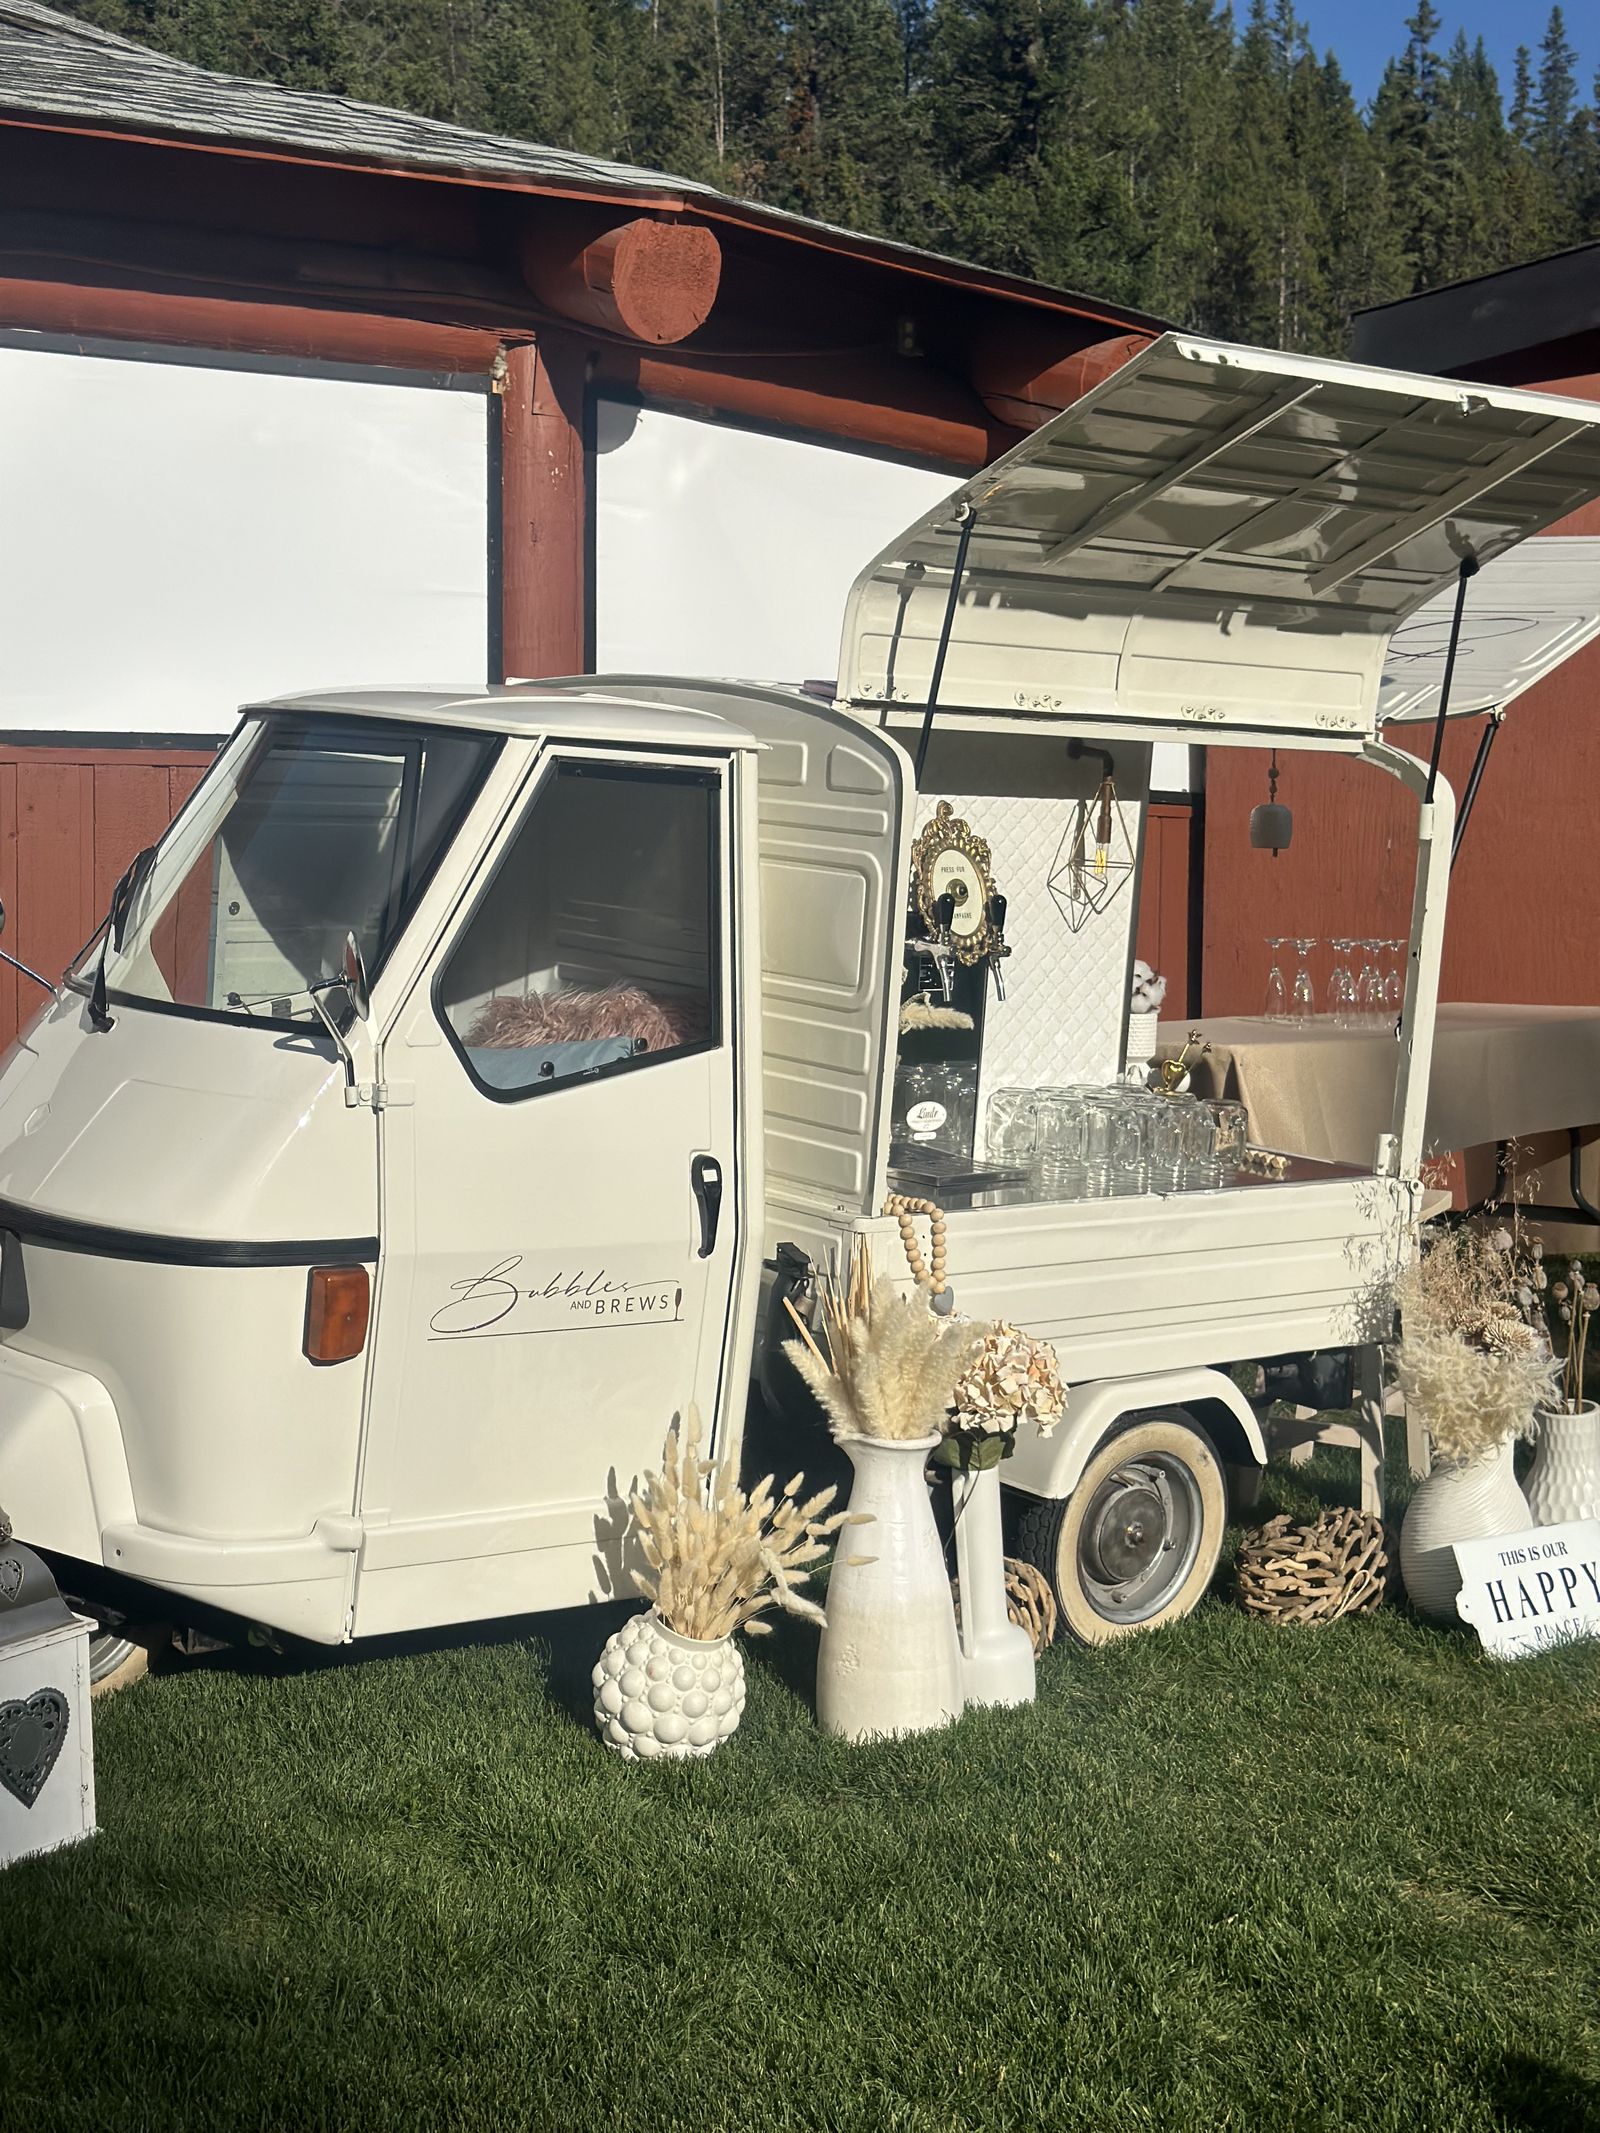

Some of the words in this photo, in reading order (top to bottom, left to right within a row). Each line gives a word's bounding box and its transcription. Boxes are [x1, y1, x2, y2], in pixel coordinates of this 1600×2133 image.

[430, 1255, 679, 1333] Bubbles
[570, 1300, 592, 1311] AND
[595, 1294, 669, 1315] BREWS
[1498, 1549, 1527, 1566] THIS
[1528, 1546, 1541, 1561] IS
[1543, 1541, 1568, 1559] OUR
[1485, 1561, 1600, 1623] HAPPY
